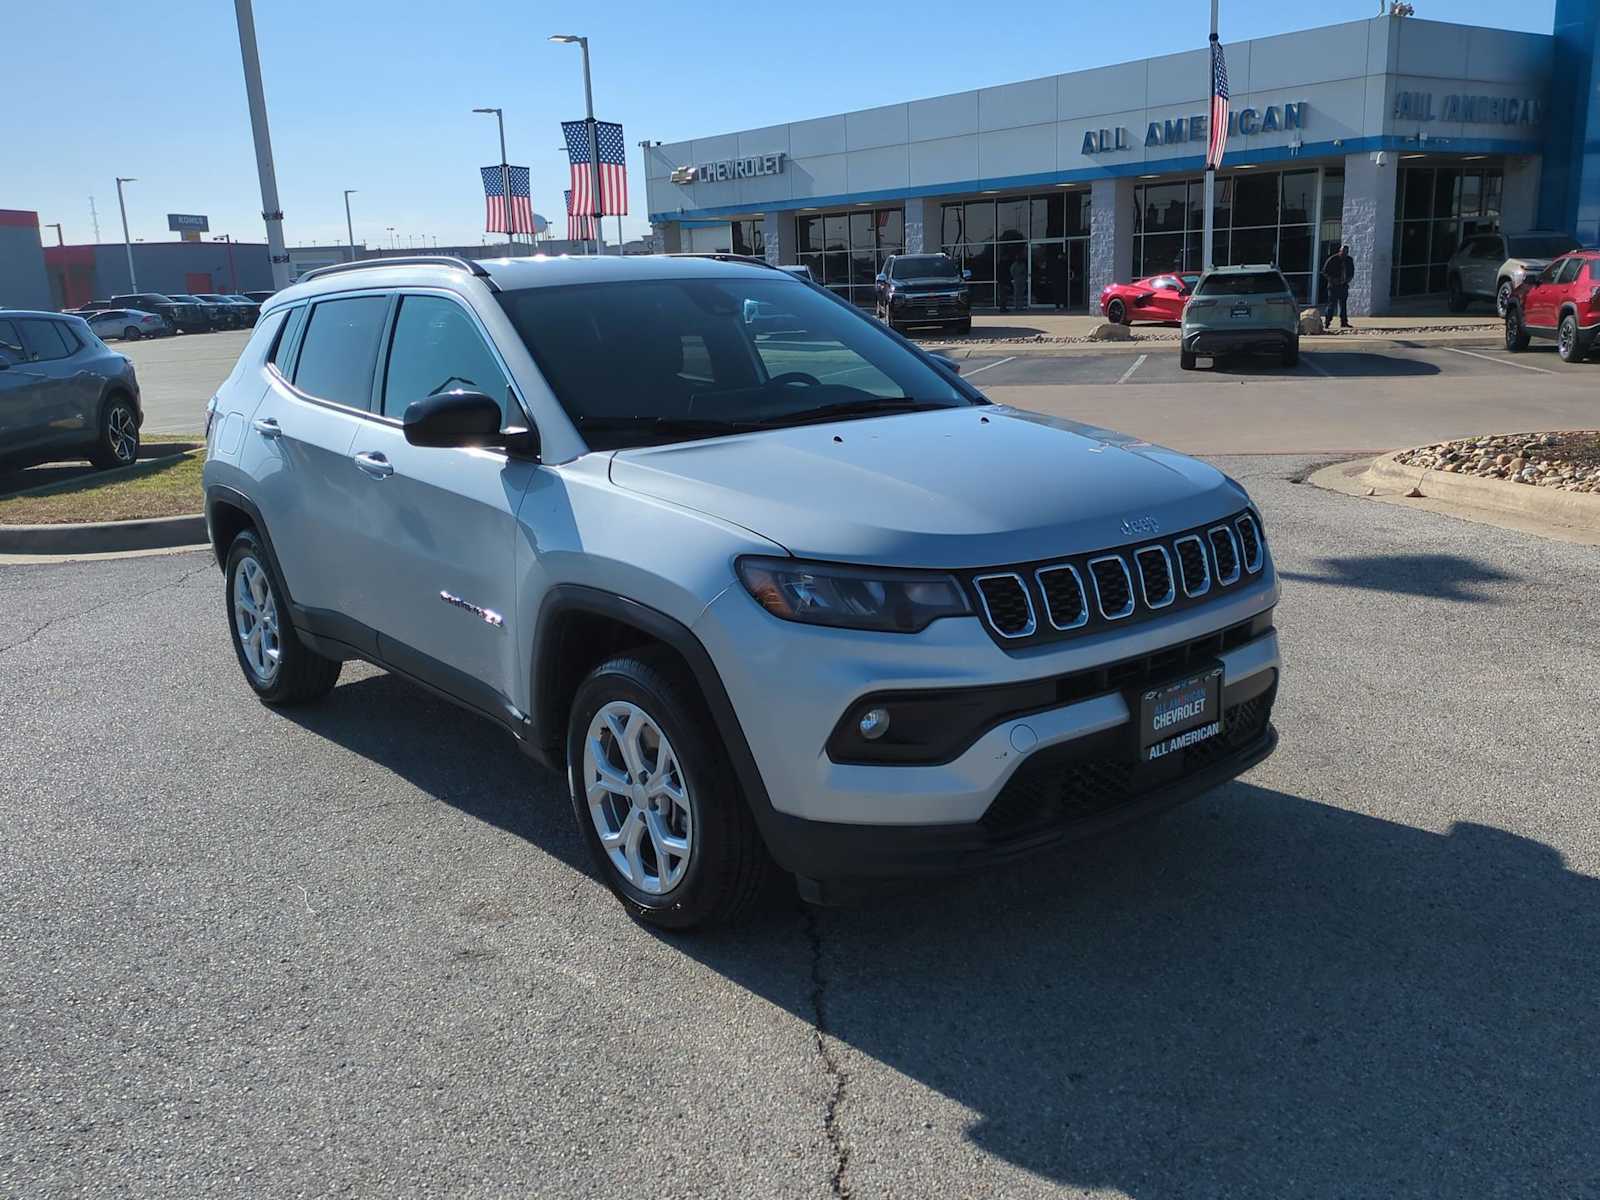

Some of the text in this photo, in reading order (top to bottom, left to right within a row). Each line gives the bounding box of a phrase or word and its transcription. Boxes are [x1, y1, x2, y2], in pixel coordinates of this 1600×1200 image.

[1081, 101, 1308, 155] ALL AMEICAN
[698, 152, 786, 183] CHEVROLET
[1153, 698, 1206, 730] CHEVROLET
[1149, 722, 1219, 760] ALL AMERICAN
